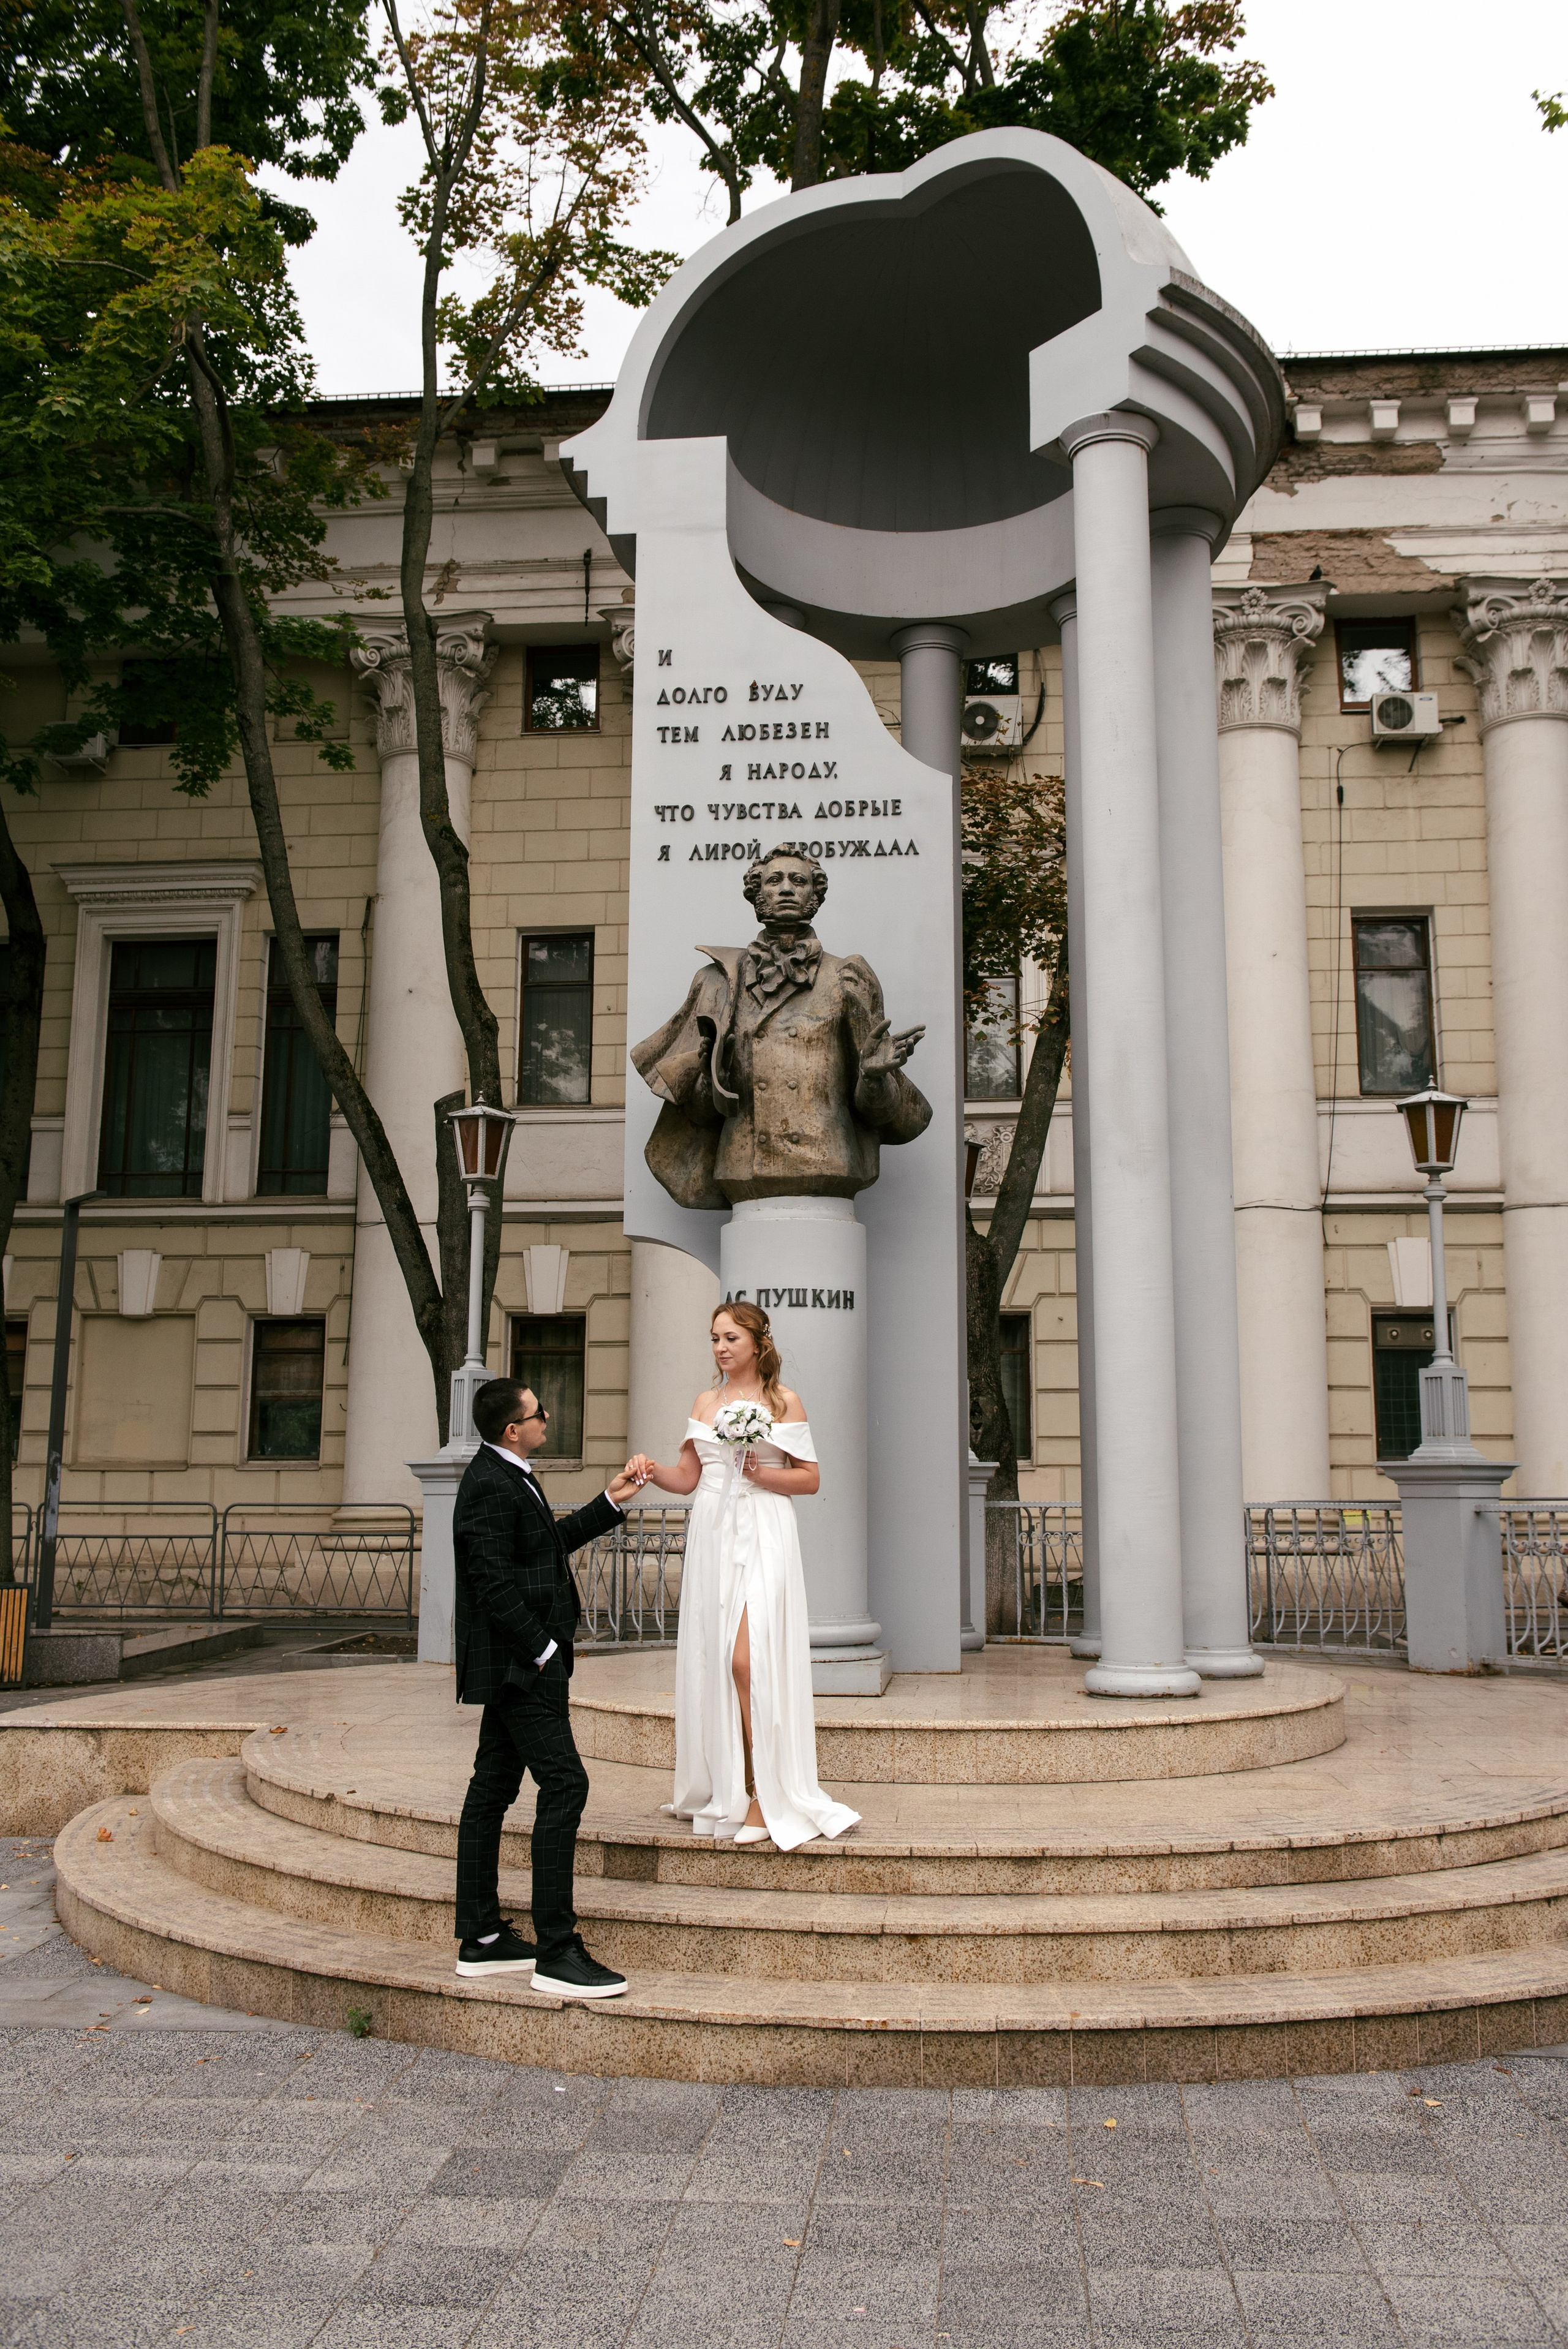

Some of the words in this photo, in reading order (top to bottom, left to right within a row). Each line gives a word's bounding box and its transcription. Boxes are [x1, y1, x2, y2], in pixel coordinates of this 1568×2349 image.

[658, 649, 673, 666] И
[657, 686, 728, 706] ДОЛГО
[748, 684, 804, 702] БУДУ
[657, 726, 699, 744] ТЕМ
[721, 722, 830, 742] ЛЮБЕЗЕН
[719, 764, 732, 781] Я
[747, 761, 838, 780] НАРОДУ,
[654, 804, 695, 822] ЧТО
[707, 802, 802, 821] ЧУВСТВА
[814, 799, 902, 819] ДОБРЫЕ
[657, 845, 671, 861] Я
[688, 838, 762, 861] ЛИРОЙ
[756, 1288, 855, 1310] ПУШКИН
